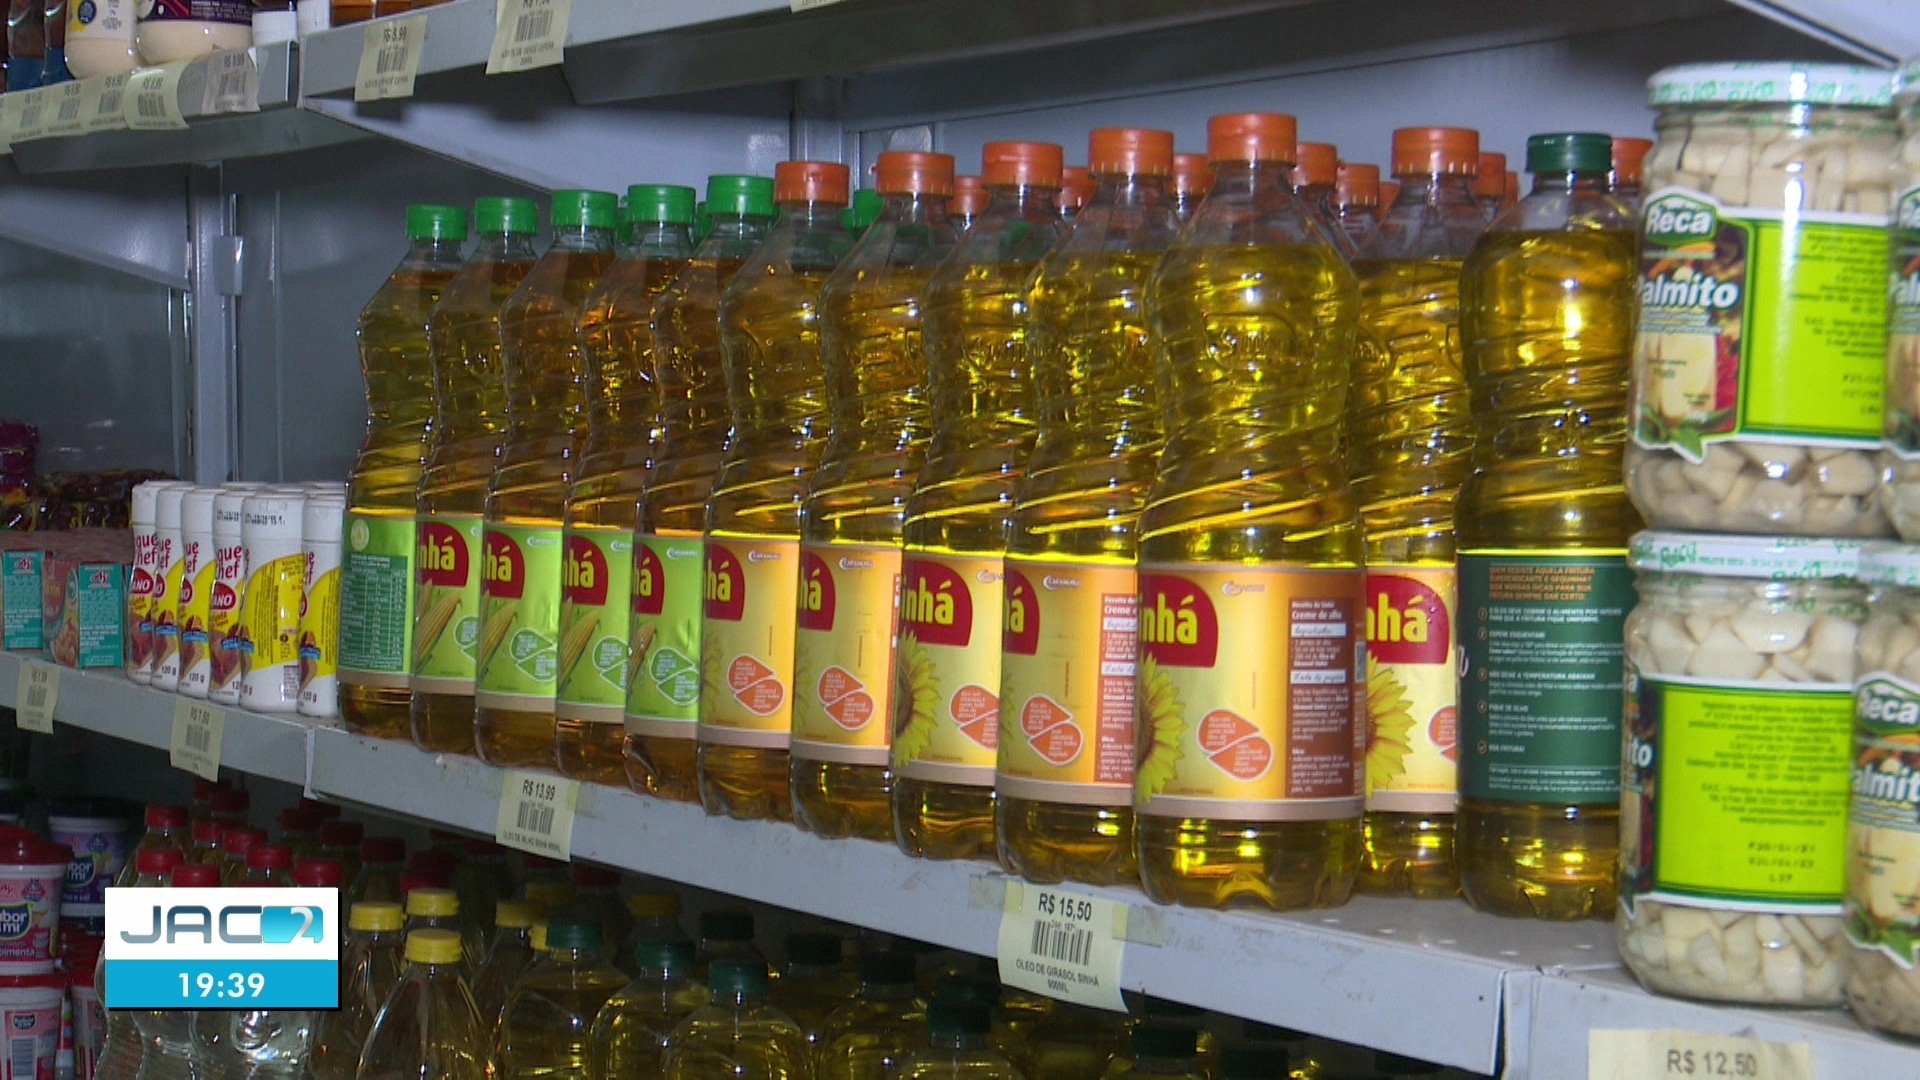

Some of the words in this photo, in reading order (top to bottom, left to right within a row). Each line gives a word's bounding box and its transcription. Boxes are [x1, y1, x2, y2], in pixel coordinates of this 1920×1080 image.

[1645, 204, 1713, 235] Reca
[418, 534, 456, 571] nhá
[523, 779, 534, 797] R$
[1038, 893, 1055, 915] R$
[1060, 898, 1092, 922] 15,50
[1035, 963, 1046, 976] DE
[1047, 965, 1076, 983] GIRASOL
[1667, 1050, 1695, 1077] R$
[1702, 1051, 1756, 1078] 12,50
